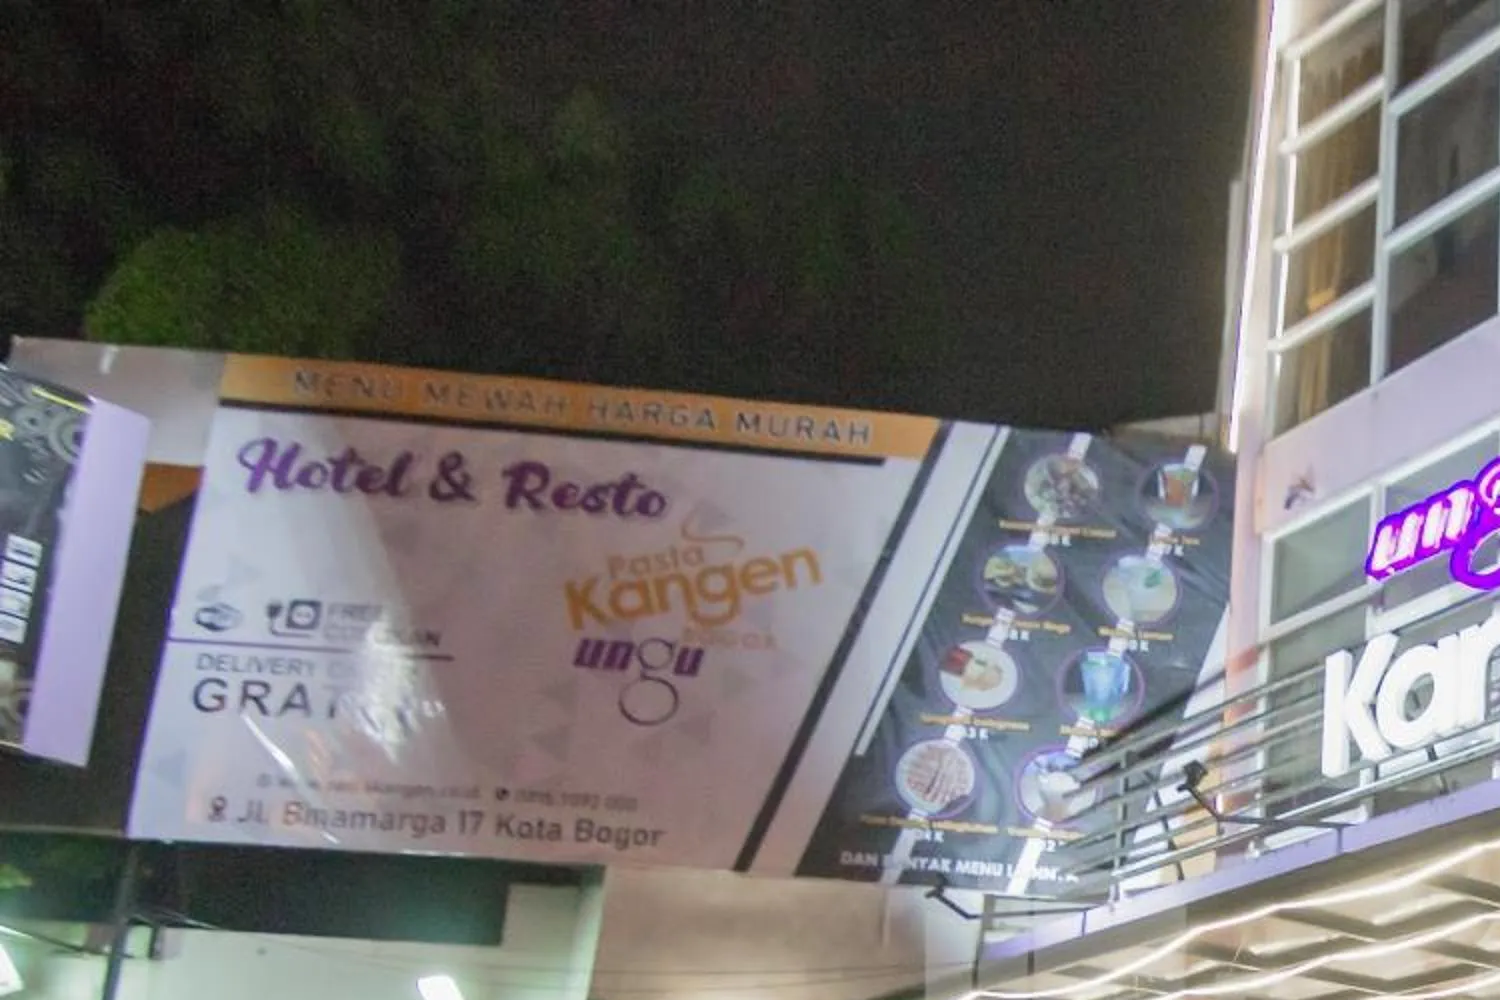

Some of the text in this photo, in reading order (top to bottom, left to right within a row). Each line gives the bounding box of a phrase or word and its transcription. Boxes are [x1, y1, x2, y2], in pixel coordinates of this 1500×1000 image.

[293, 367, 872, 445] MENU MEWAH HARGA MURAH
[238, 435, 669, 521] Hotel & Resto
[564, 545, 823, 632] Kangen
[195, 652, 317, 677] DELIVERY
[572, 636, 706, 726] ungu
[192, 676, 385, 719] GRAT
[457, 808, 483, 836] 17
[494, 811, 562, 844] Kota
[574, 818, 666, 852] Bogor
[839, 851, 878, 868] DAN
[953, 860, 1002, 878] MENU
